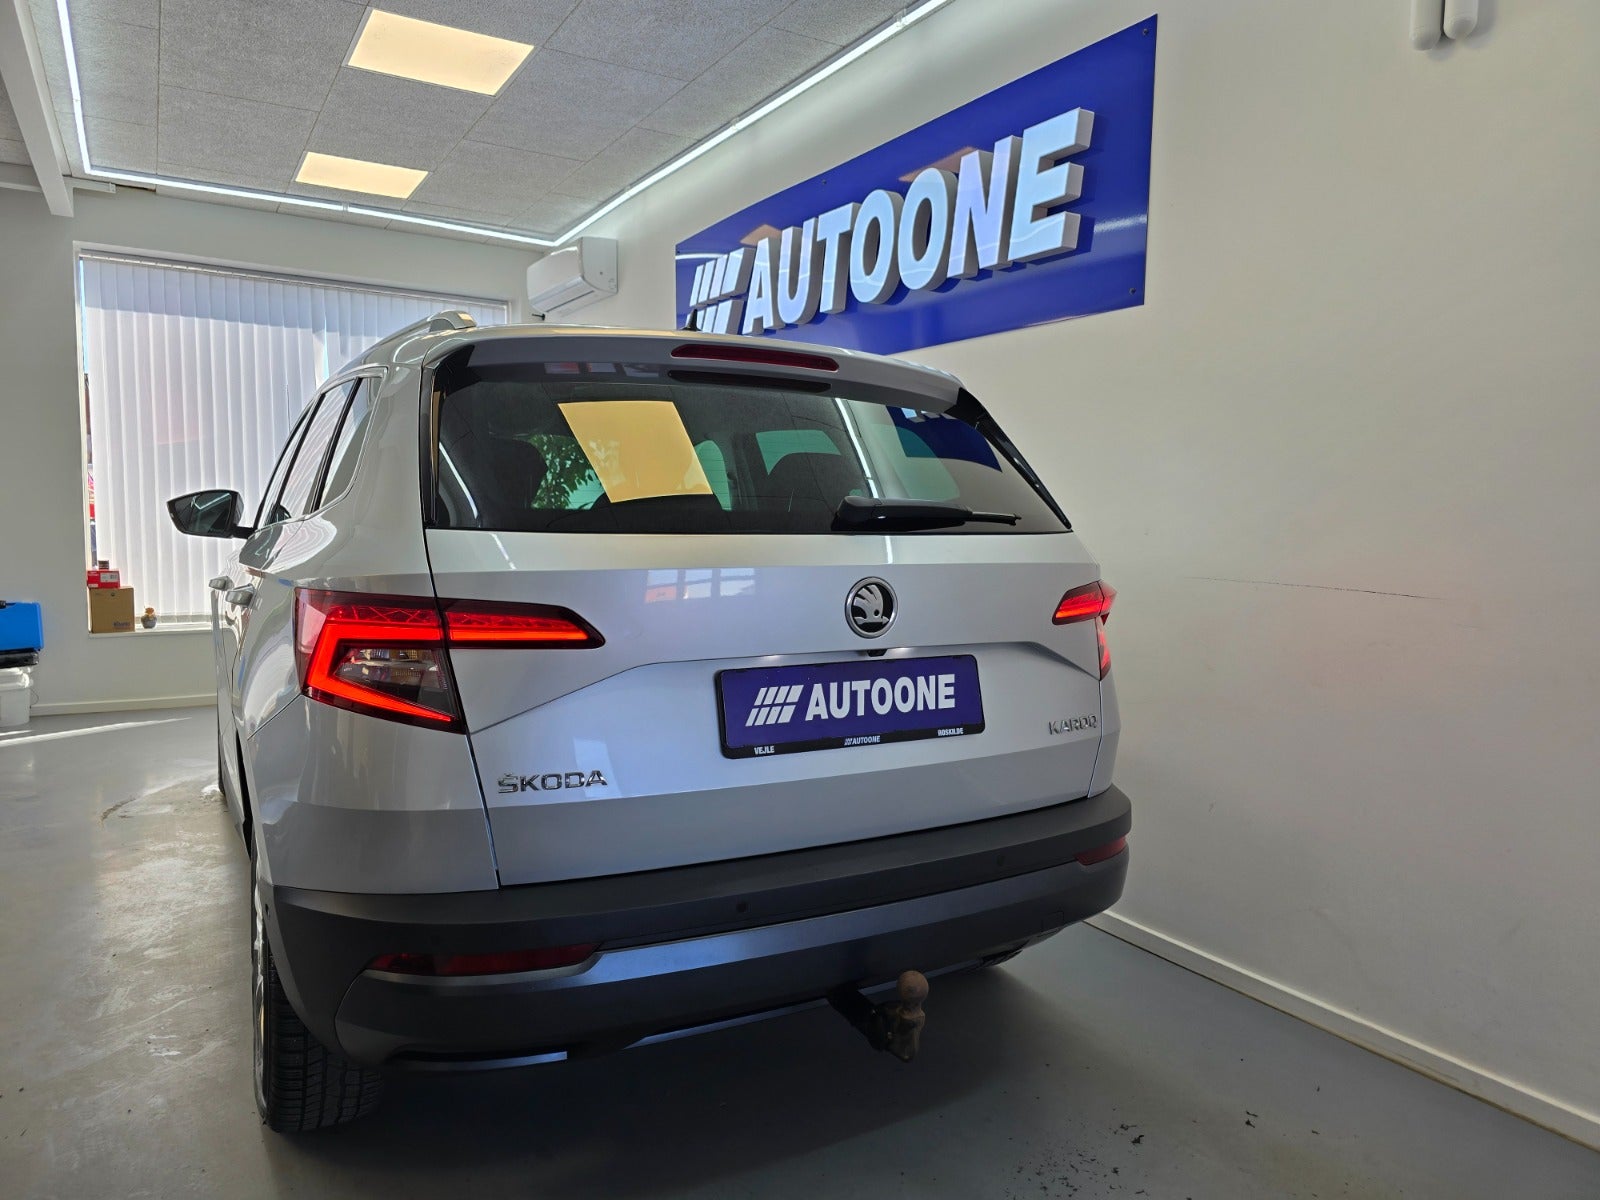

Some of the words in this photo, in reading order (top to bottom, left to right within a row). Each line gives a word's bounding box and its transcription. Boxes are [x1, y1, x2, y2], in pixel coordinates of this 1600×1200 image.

[743, 107, 1095, 335] AUTOONE
[804, 673, 956, 721] AUTOONE
[754, 745, 775, 755] VEJLE
[851, 735, 881, 745] AUTOONE
